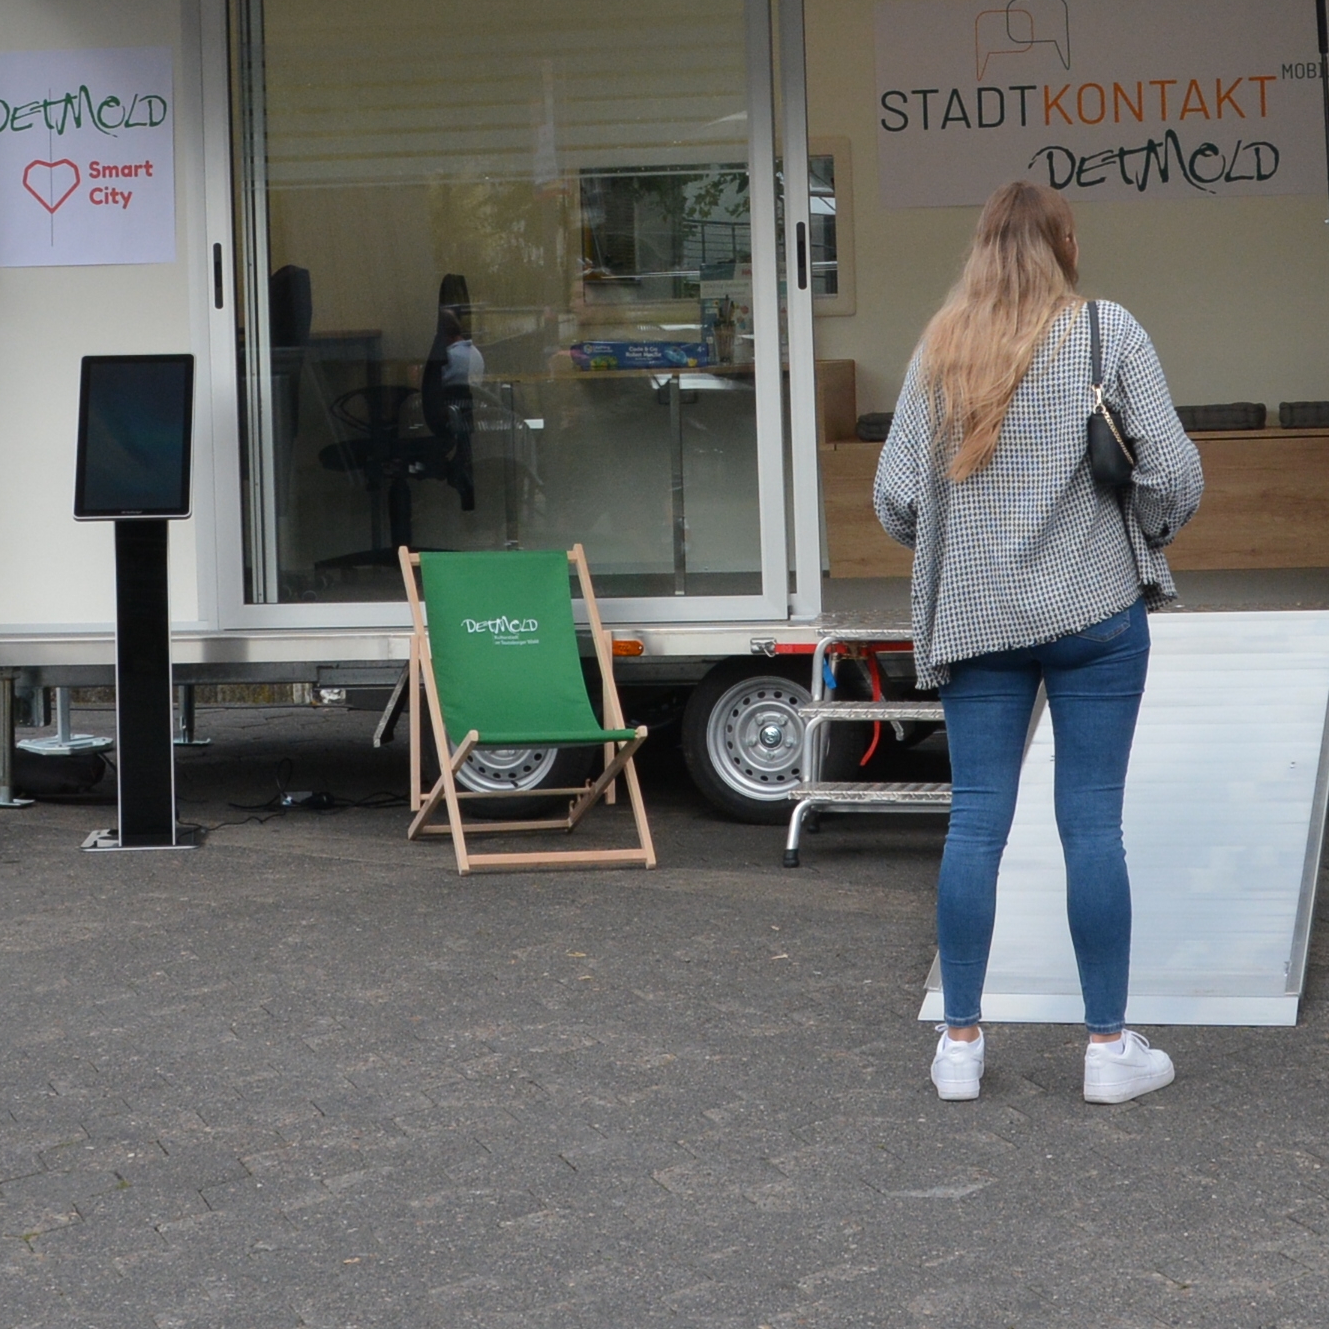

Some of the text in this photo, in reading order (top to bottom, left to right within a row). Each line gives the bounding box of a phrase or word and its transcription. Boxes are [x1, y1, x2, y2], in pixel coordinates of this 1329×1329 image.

[881, 75, 1277, 132] STADTKONTAKT
[89, 160, 153, 179] Smart
[1028, 128, 1279, 193] DETMOLD
[89, 186, 132, 209] City
[460, 615, 538, 634] DETMOLD
